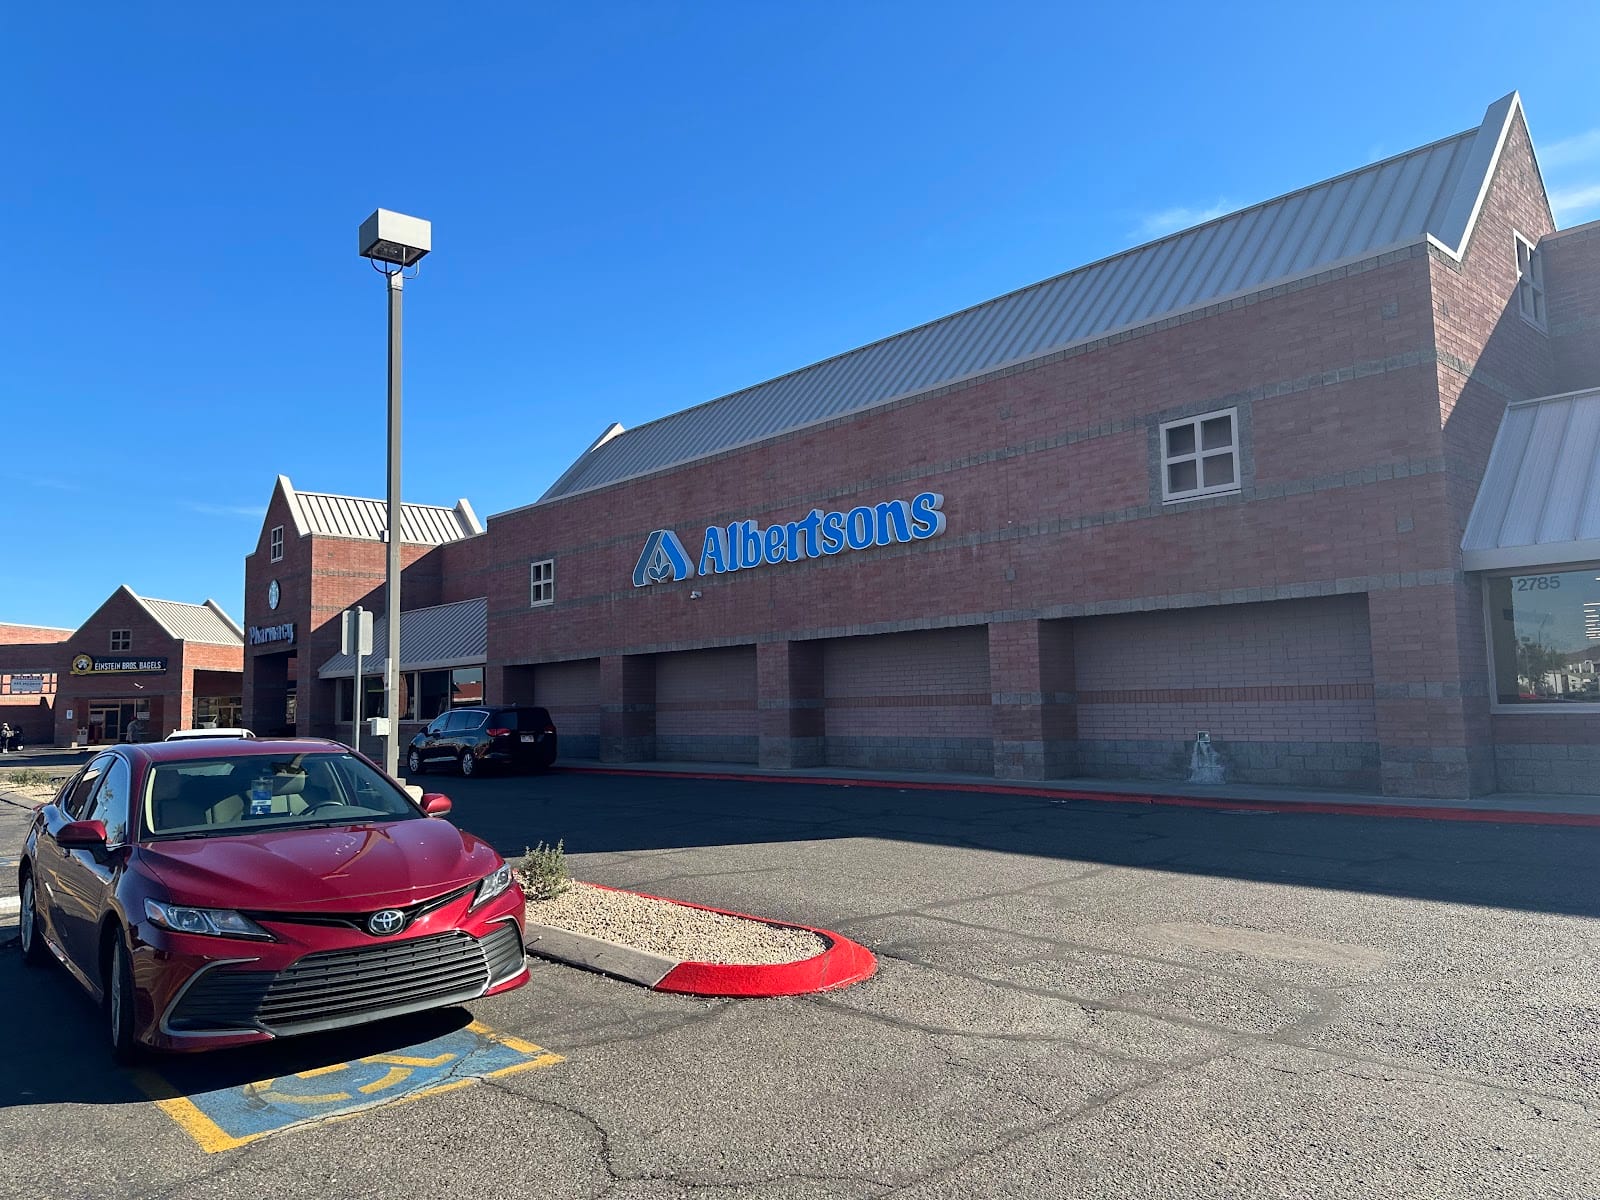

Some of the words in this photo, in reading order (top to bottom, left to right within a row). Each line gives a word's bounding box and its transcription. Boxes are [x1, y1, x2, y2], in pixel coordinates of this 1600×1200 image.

[698, 492, 946, 576] Albertsons
[1517, 575, 1561, 591] 2785
[249, 624, 294, 645] Pharmacy
[94, 662, 120, 670] EINSTEIN
[139, 661, 162, 669] BAGELS
